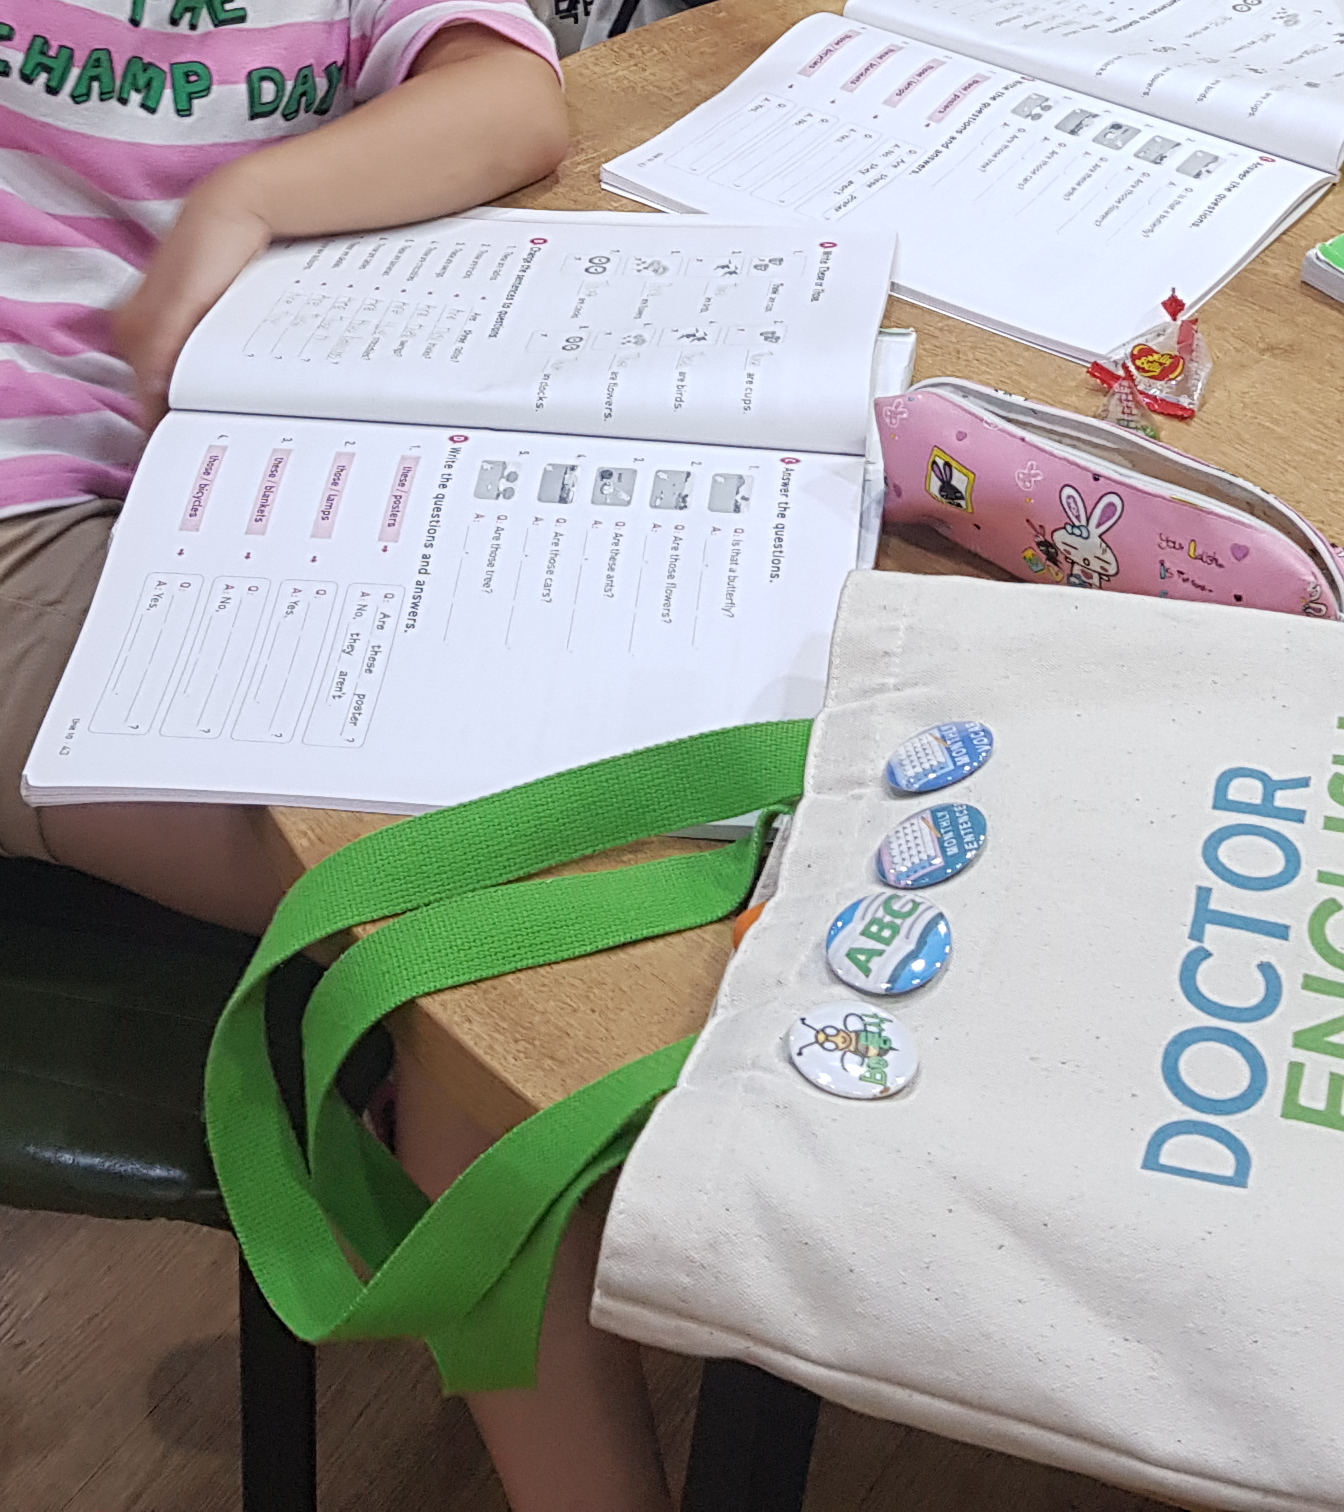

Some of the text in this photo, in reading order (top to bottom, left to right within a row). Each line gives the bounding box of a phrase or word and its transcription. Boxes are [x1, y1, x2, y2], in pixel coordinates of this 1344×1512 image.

[246, 60, 344, 121] DAY
[908, 89, 1006, 176] the questions and answers.
[1223, 177, 1240, 192] the
[1189, 193, 1227, 229] questions.
[603, 382, 619, 422] flowers.
[672, 383, 686, 414] birds.
[741, 372, 755, 415] are cups.
[189, 482, 210, 519] bicycles
[254, 457, 284, 524] these blankets
[321, 465, 346, 522] those lamps
[387, 466, 412, 529] these posters
[404, 446, 461, 633] Write the questions and answers.
[492, 526, 505, 542] Are
[551, 531, 564, 547] Are
[611, 532, 624, 547] Are
[768, 466, 795, 584] Answer the questions.
[487, 543, 501, 569] those
[670, 536, 683, 551] Are
[729, 549, 742, 566] that
[731, 539, 743, 547] Is
[546, 549, 560, 575] those
[666, 554, 680, 580] those
[247, 585, 259, 596] Q:
[383, 592, 395, 603] Q:
[481, 570, 496, 595] tree?
[540, 578, 553, 604] cars?
[603, 574, 614, 600] ants?
[721, 575, 738, 619] butterfly?
[146, 592, 164, 612] Yes,
[215, 596, 232, 613] No,
[283, 587, 303, 619] A: Yes,
[661, 582, 677, 625] flowers?
[376, 611, 391, 631] Are
[331, 591, 371, 701] A: No, they aren't
[349, 693, 366, 727] poster
[940, 724, 971, 766] MONTHLY
[936, 810, 960, 857] MONTHLY
[845, 893, 922, 979] ABC
[1141, 766, 1313, 1189] DOCTOR
